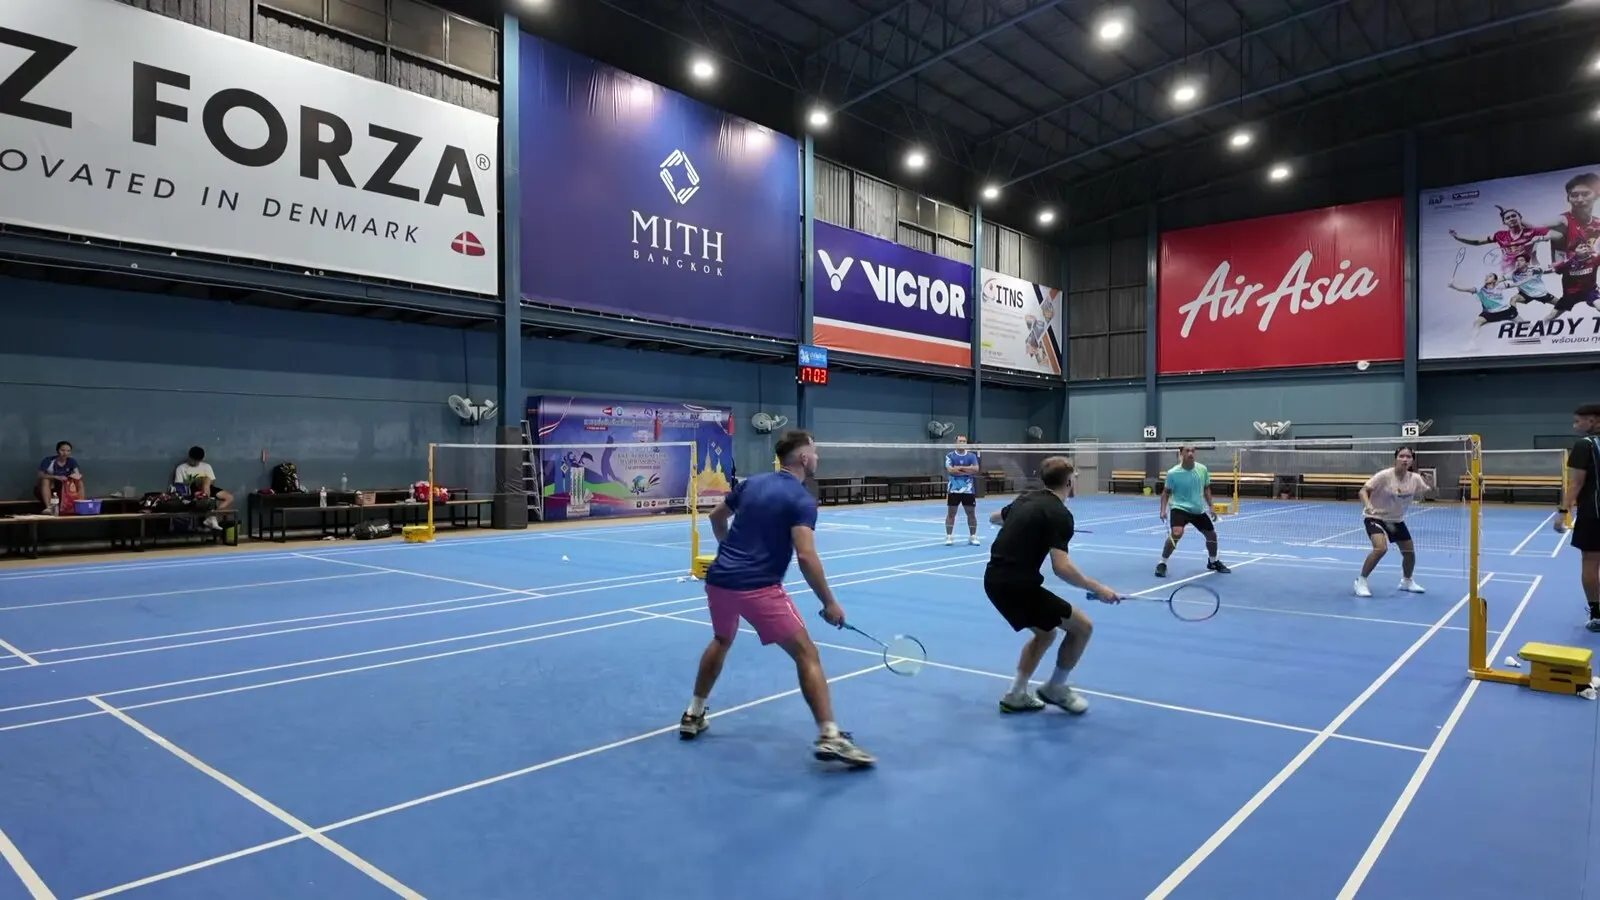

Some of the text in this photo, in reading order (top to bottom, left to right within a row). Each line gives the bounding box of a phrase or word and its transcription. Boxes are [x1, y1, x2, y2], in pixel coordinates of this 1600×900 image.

[133, 61, 485, 217] FORZA
[202, 186, 239, 211] IN
[262, 198, 419, 244] DENMARK
[631, 209, 723, 263] MITH
[633, 249, 723, 277] BANGKOK
[860, 259, 966, 319] VICTOR
[996, 285, 1024, 309] ITNS
[1498, 317, 1584, 339] READY
[1146, 429, 1155, 437] 16
[1405, 427, 1416, 436] 15
